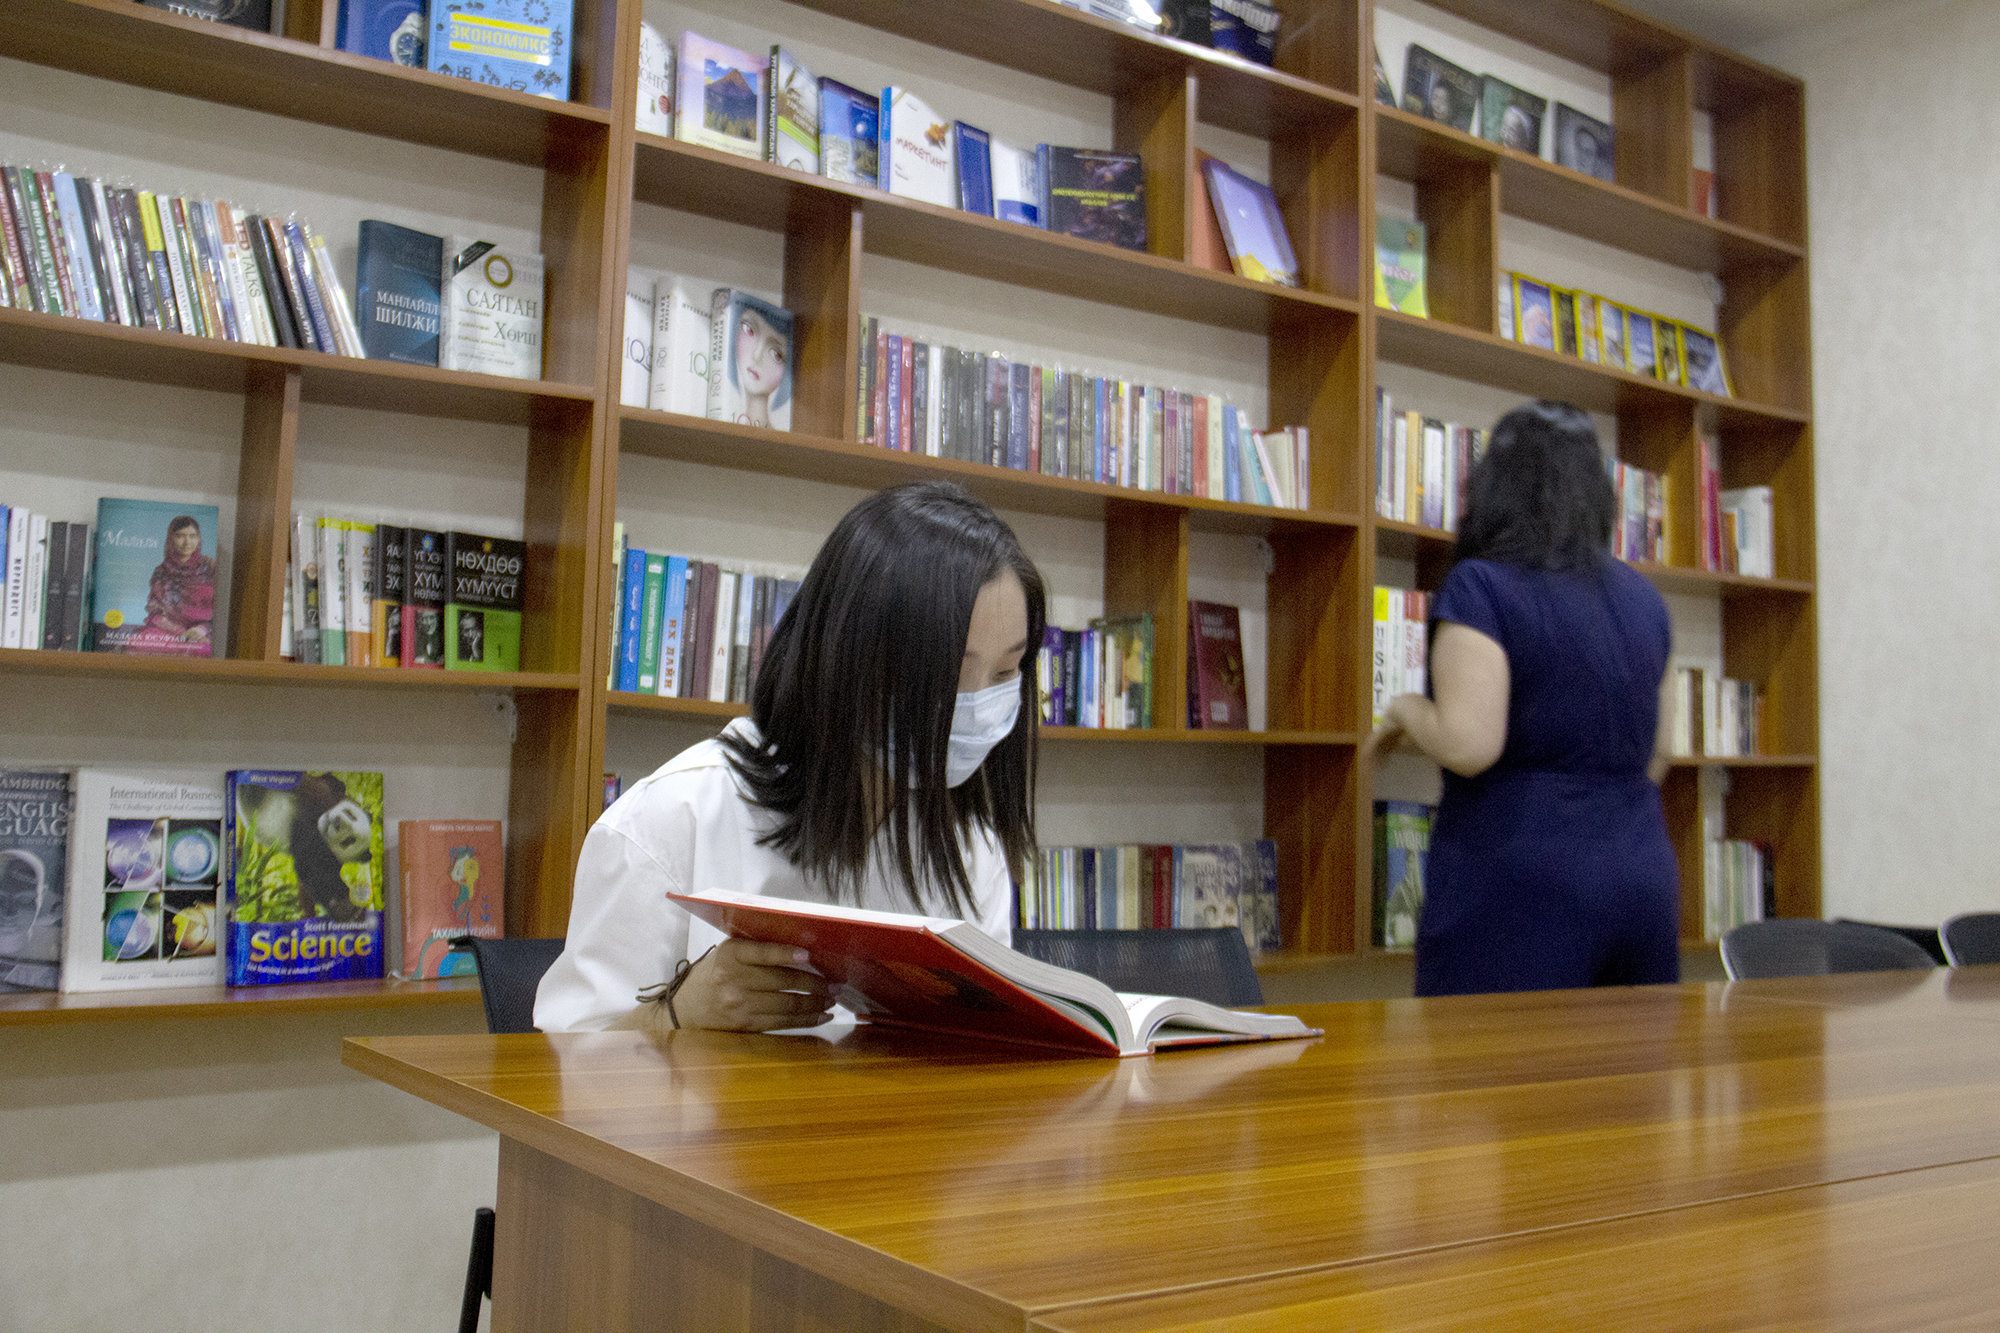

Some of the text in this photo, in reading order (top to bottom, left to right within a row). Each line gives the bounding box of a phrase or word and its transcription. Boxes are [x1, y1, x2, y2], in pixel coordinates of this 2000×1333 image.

[450, 24, 550, 53] ЭКОНОМИКС
[235, 219, 262, 298] TED TALKS
[467, 288, 537, 318] САЯТАН
[376, 307, 439, 334] ШИЛЖИ
[494, 321, 537, 346] ХӨРШ
[456, 551, 520, 575] НӨХДӨӨ
[456, 577, 517, 599] ХҮМҮҮСТ
[105, 631, 142, 641] МАЛАЛА
[664, 646, 675, 690] ДАЙН
[109, 786, 222, 801] International Business
[304, 919, 369, 932] Scott Foresman
[250, 928, 371, 962] Science
